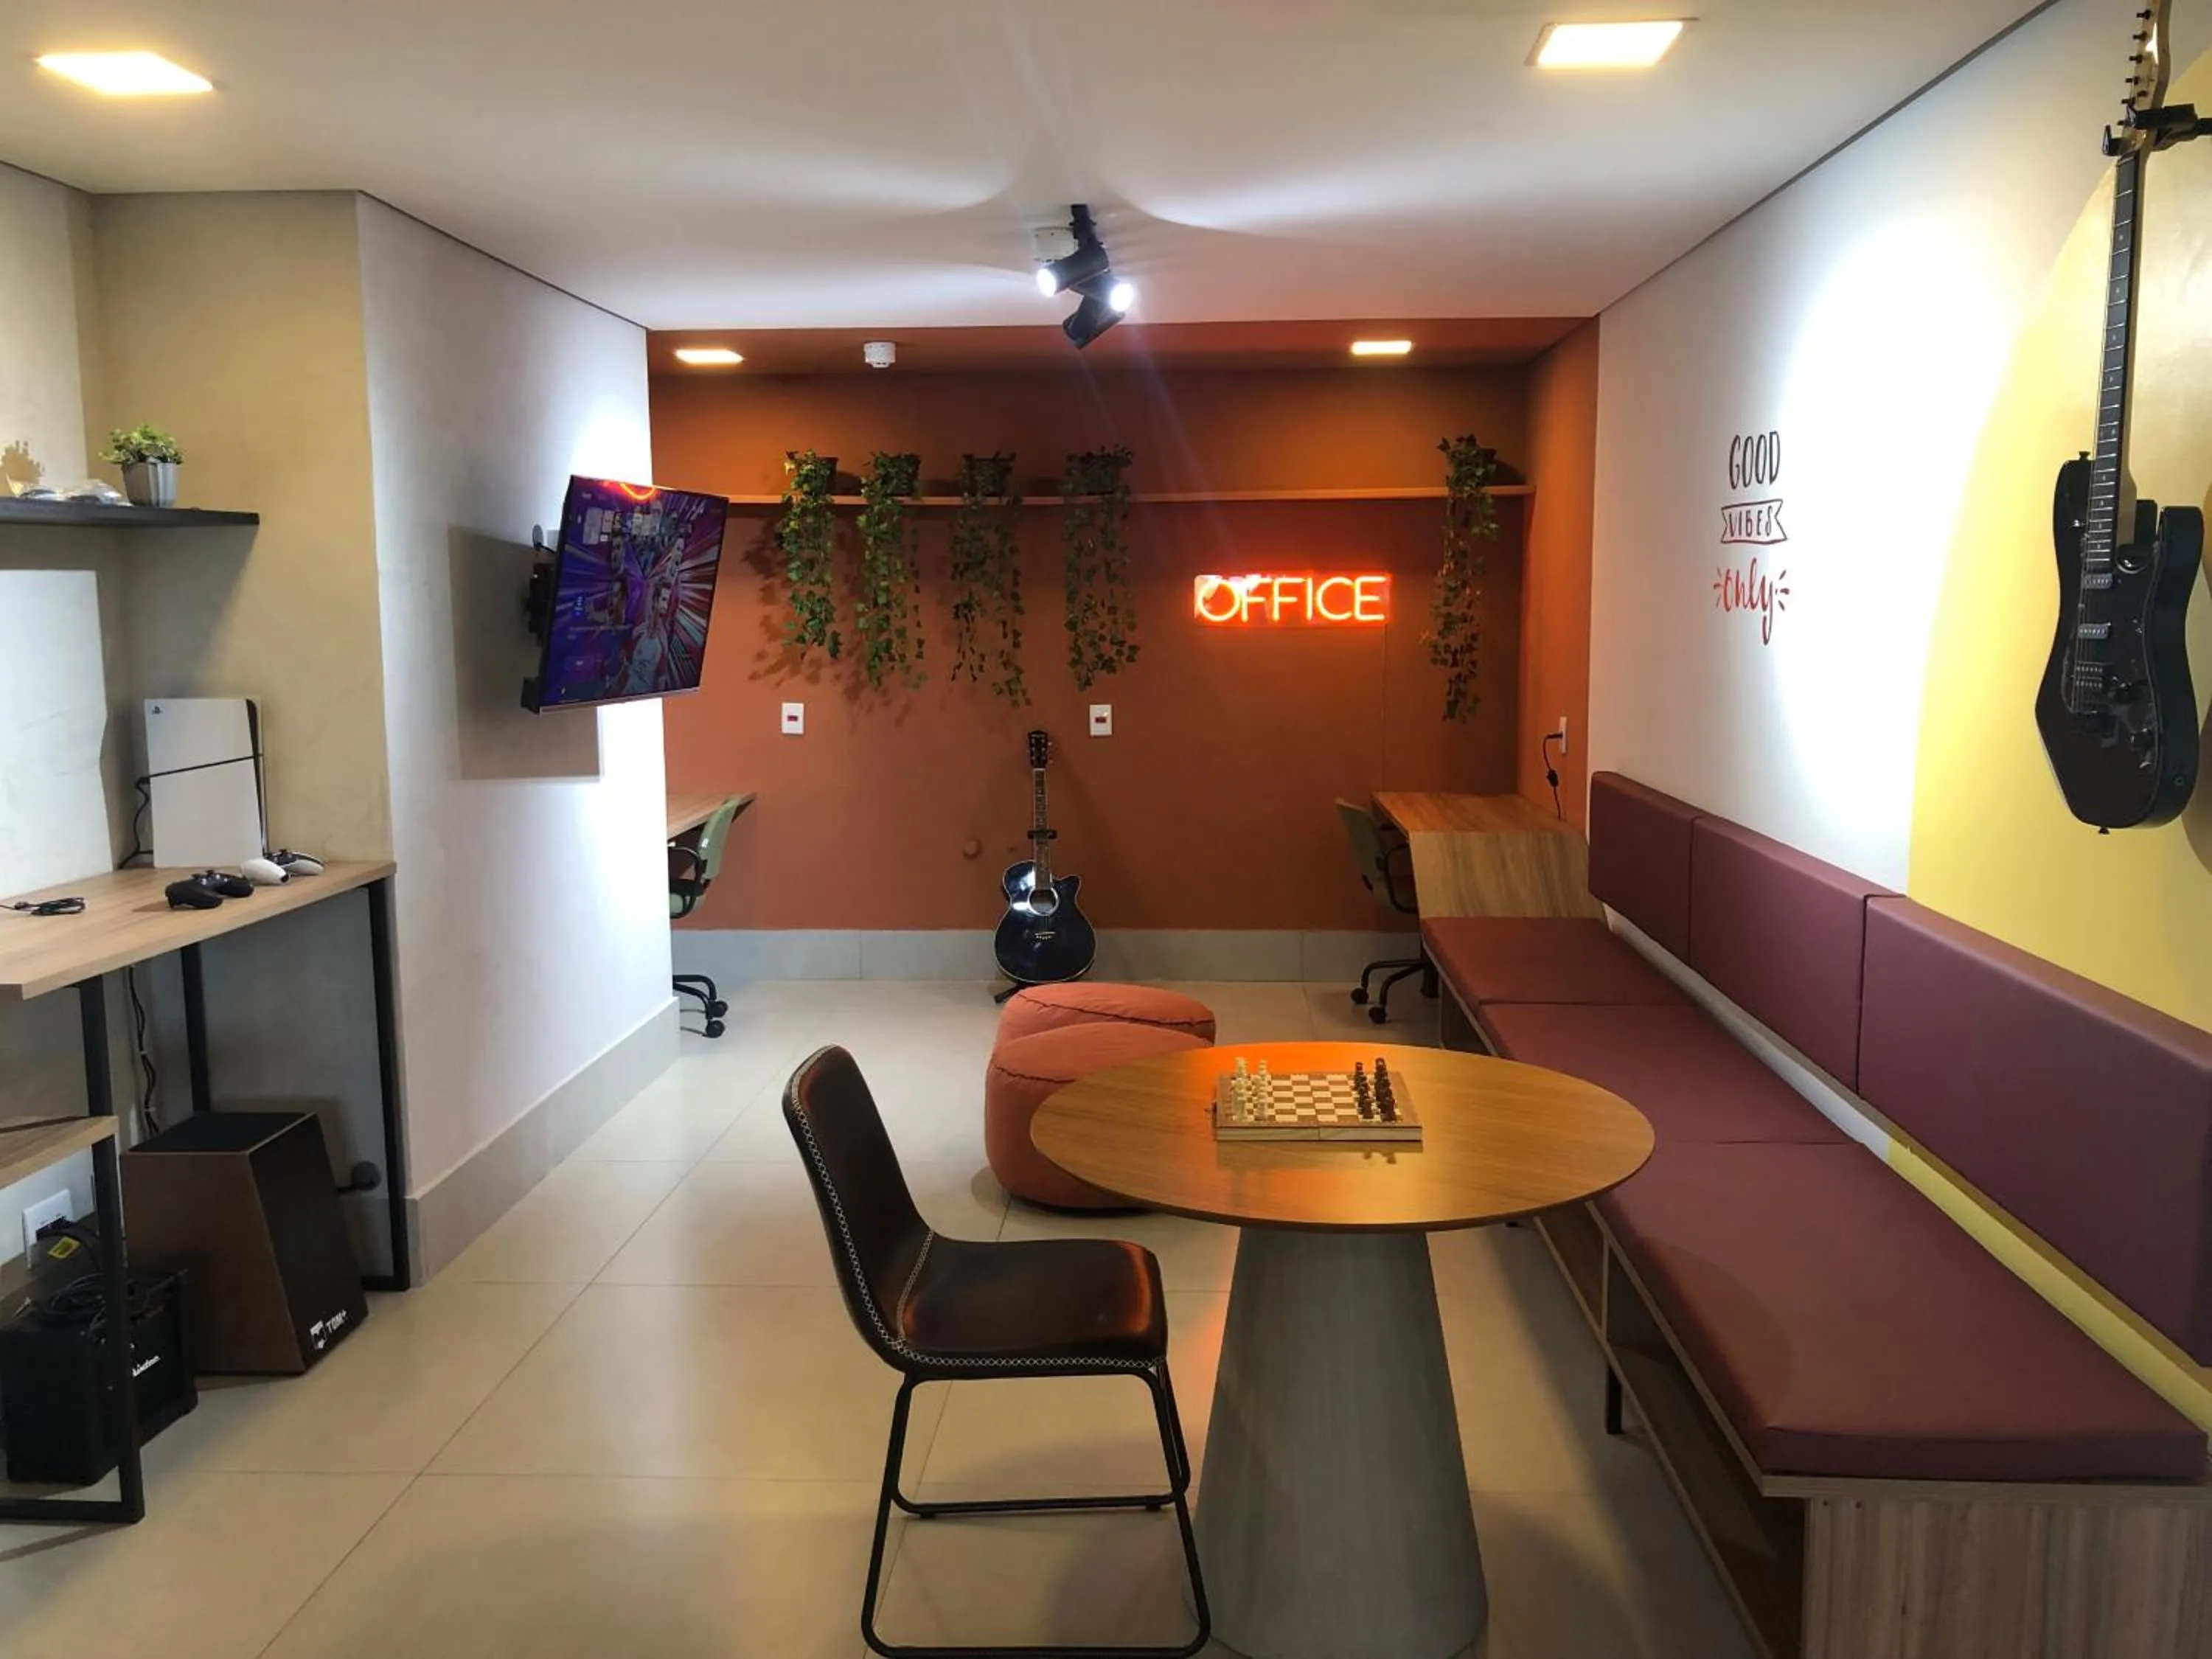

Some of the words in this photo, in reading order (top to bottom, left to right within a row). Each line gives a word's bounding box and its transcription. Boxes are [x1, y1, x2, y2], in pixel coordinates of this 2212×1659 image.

[1729, 431, 1781, 490] GOOD
[1728, 505, 1773, 538] VIBES
[1197, 575, 1385, 622] OFFICE
